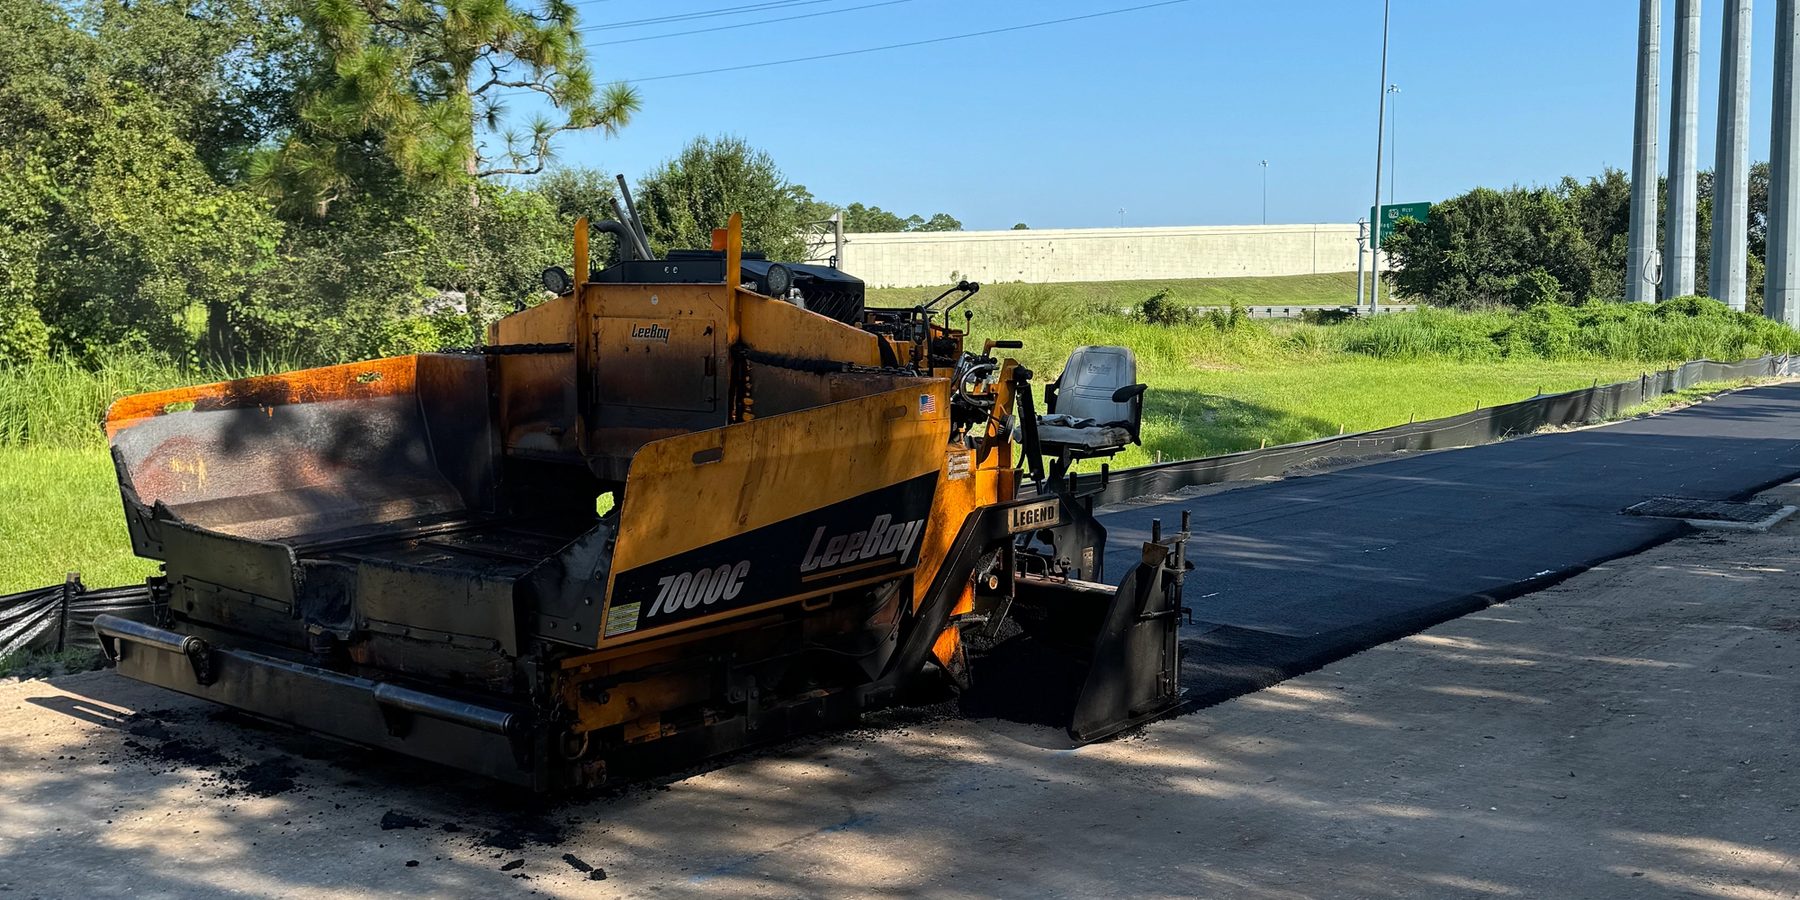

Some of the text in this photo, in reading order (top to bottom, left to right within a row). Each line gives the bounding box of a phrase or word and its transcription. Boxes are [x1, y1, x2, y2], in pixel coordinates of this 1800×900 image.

[631, 323, 670, 344] LeeBoy
[1013, 506, 1055, 527] LEGEND
[800, 514, 924, 572] LeeBoy
[647, 560, 750, 618] 7000C
